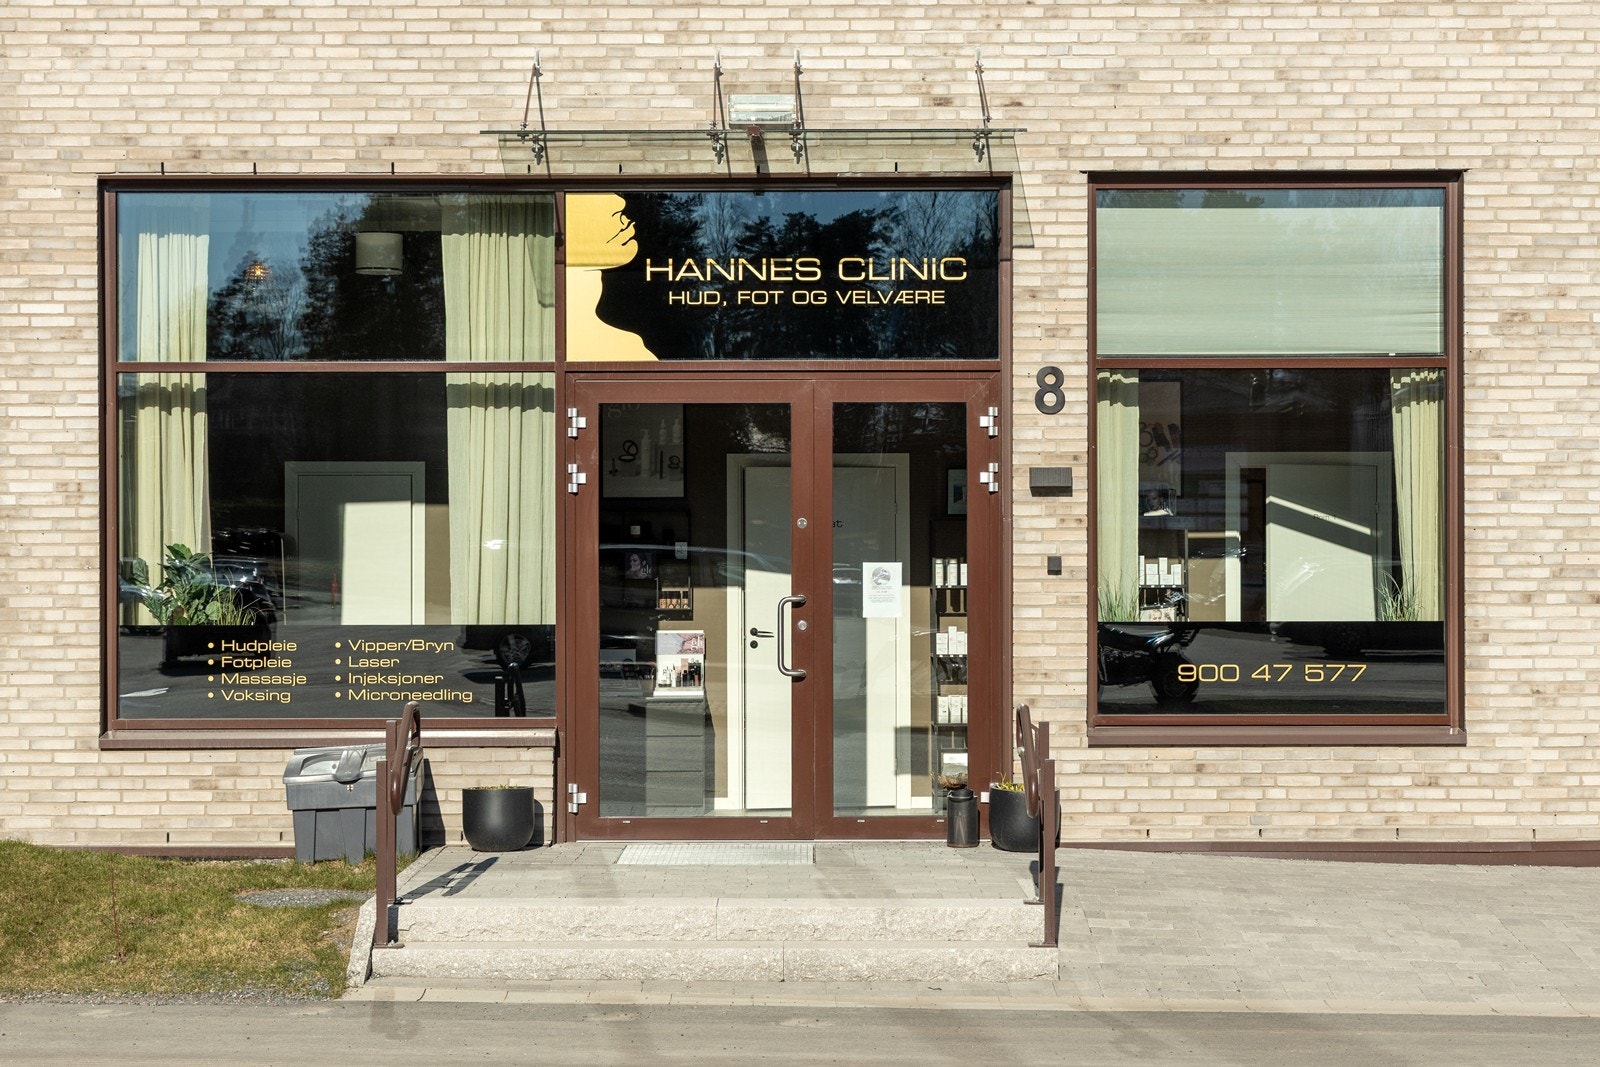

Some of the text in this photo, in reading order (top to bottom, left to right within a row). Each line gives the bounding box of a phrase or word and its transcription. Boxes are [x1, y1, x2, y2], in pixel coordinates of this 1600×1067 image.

[645, 257, 969, 282] HANNES CLINIC
[668, 290, 946, 307] HUD, FOT OG VELVÆRE
[1035, 366, 1065, 415] 8
[220, 639, 298, 654] Hudpleie
[348, 639, 455, 653] Vipper/Bryn
[220, 655, 292, 670] Fotpleie
[348, 656, 400, 669] Laser
[220, 672, 307, 687] Massasje
[348, 672, 444, 687] Injeksjoner
[1177, 663, 1368, 683] 900 47 577
[220, 689, 292, 704] Voksing
[348, 688, 473, 704] Microneedling
